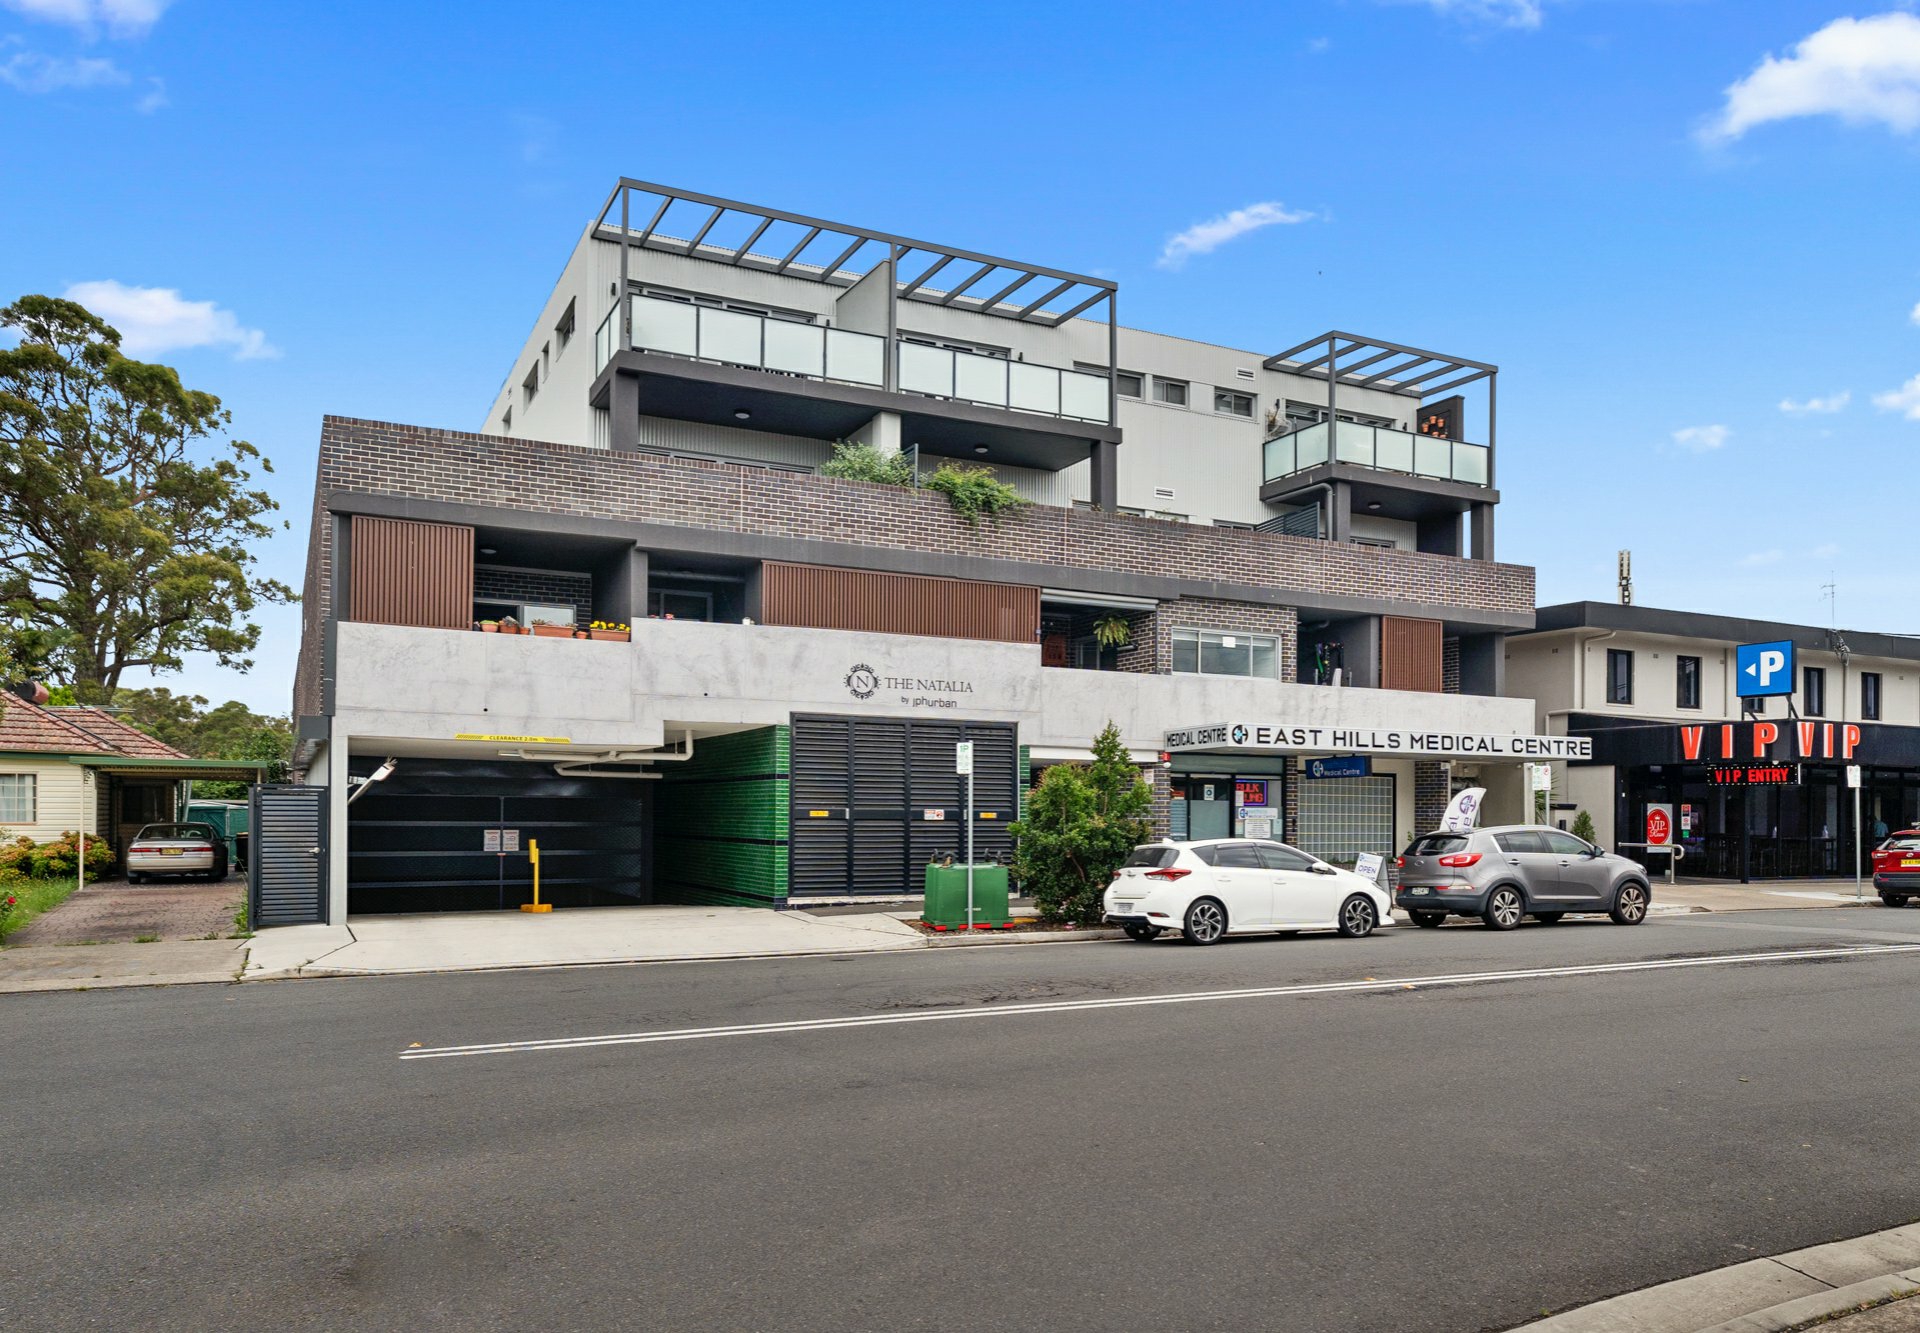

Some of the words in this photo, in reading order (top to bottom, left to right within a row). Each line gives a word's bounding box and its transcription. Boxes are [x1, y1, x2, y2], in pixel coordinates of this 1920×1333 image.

[1760, 650, 1785, 687] P
[856, 675, 870, 689] N
[885, 677, 914, 690] THE
[917, 679, 973, 692] NATALIA
[901, 695, 910, 705] by
[1167, 732, 1195, 748] MEDICAL
[1198, 727, 1227, 745] CENTRE
[1256, 727, 1323, 746] EAST
[1333, 730, 1401, 749] HILLS
[1410, 733, 1503, 752] MEDICAL
[1511, 738, 1591, 756] CENTRE
[1681, 722, 1779, 760] VIP
[1797, 721, 1861, 759] VIP
[1324, 769, 1342, 777] Medical
[1343, 768, 1360, 776] Centre
[1715, 770, 1742, 783] VIP
[1748, 768, 1789, 782] ENTRY
[1650, 820, 1666, 831] VIP
[1358, 864, 1377, 875] OPEN
